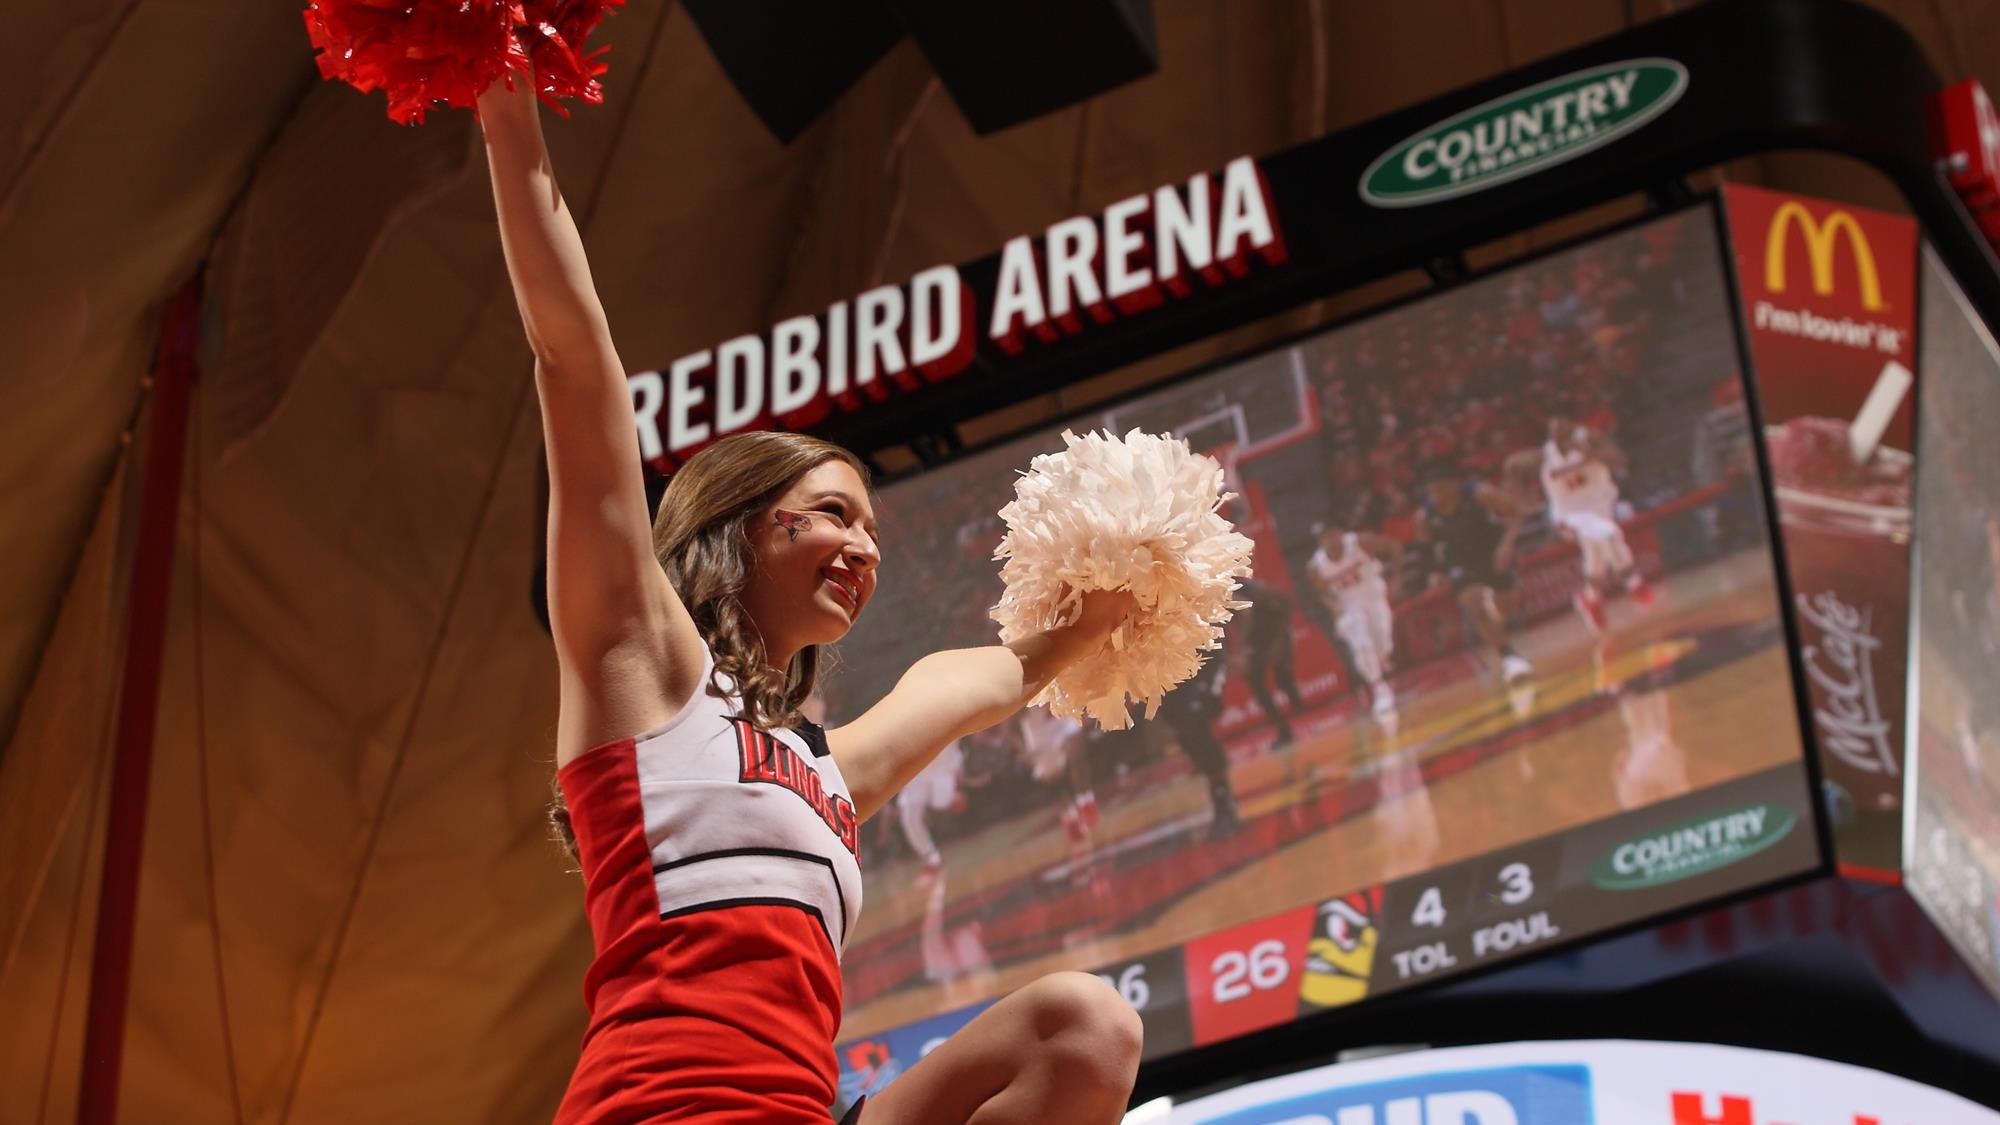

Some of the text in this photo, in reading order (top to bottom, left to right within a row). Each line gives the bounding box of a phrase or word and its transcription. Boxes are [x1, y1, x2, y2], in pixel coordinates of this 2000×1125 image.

[1402, 69, 1639, 180] COUNTRY
[1449, 115, 1597, 182] FINANCIAL
[626, 155, 1275, 462] REDBIRD ARENA
[1754, 300, 1799, 334] I'm
[1612, 806, 1768, 875] COUNTRY
[1411, 862, 1535, 928] 4 3
[1210, 938, 1290, 1004] 26
[1391, 910, 1561, 979] TOL FOUL
